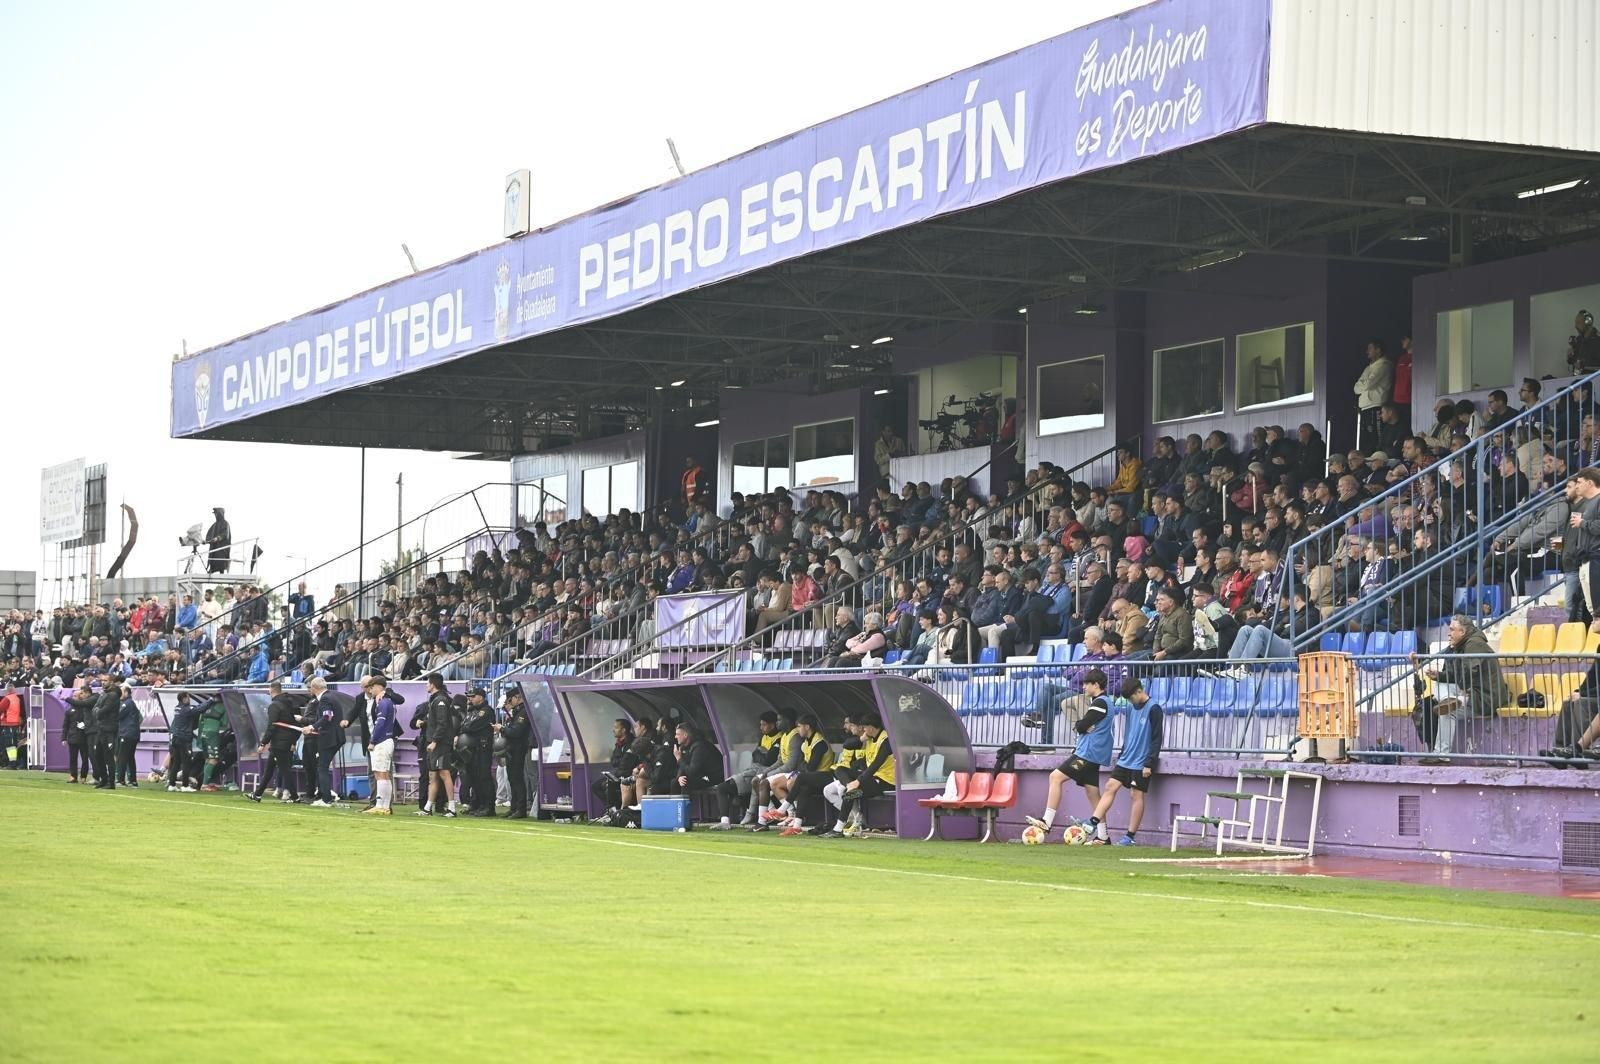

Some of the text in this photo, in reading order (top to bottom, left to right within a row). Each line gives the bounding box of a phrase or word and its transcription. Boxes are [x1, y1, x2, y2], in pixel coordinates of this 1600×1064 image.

[1075, 23, 1207, 112] Guadalajara
[1075, 78, 1202, 158] es Deporte
[222, 79, 1026, 411] CAMPO DE FÚTBOL PEDRO ESCARTÍN
[516, 263, 555, 300] Ayuntamiento
[523, 291, 556, 321] Guadalajara
